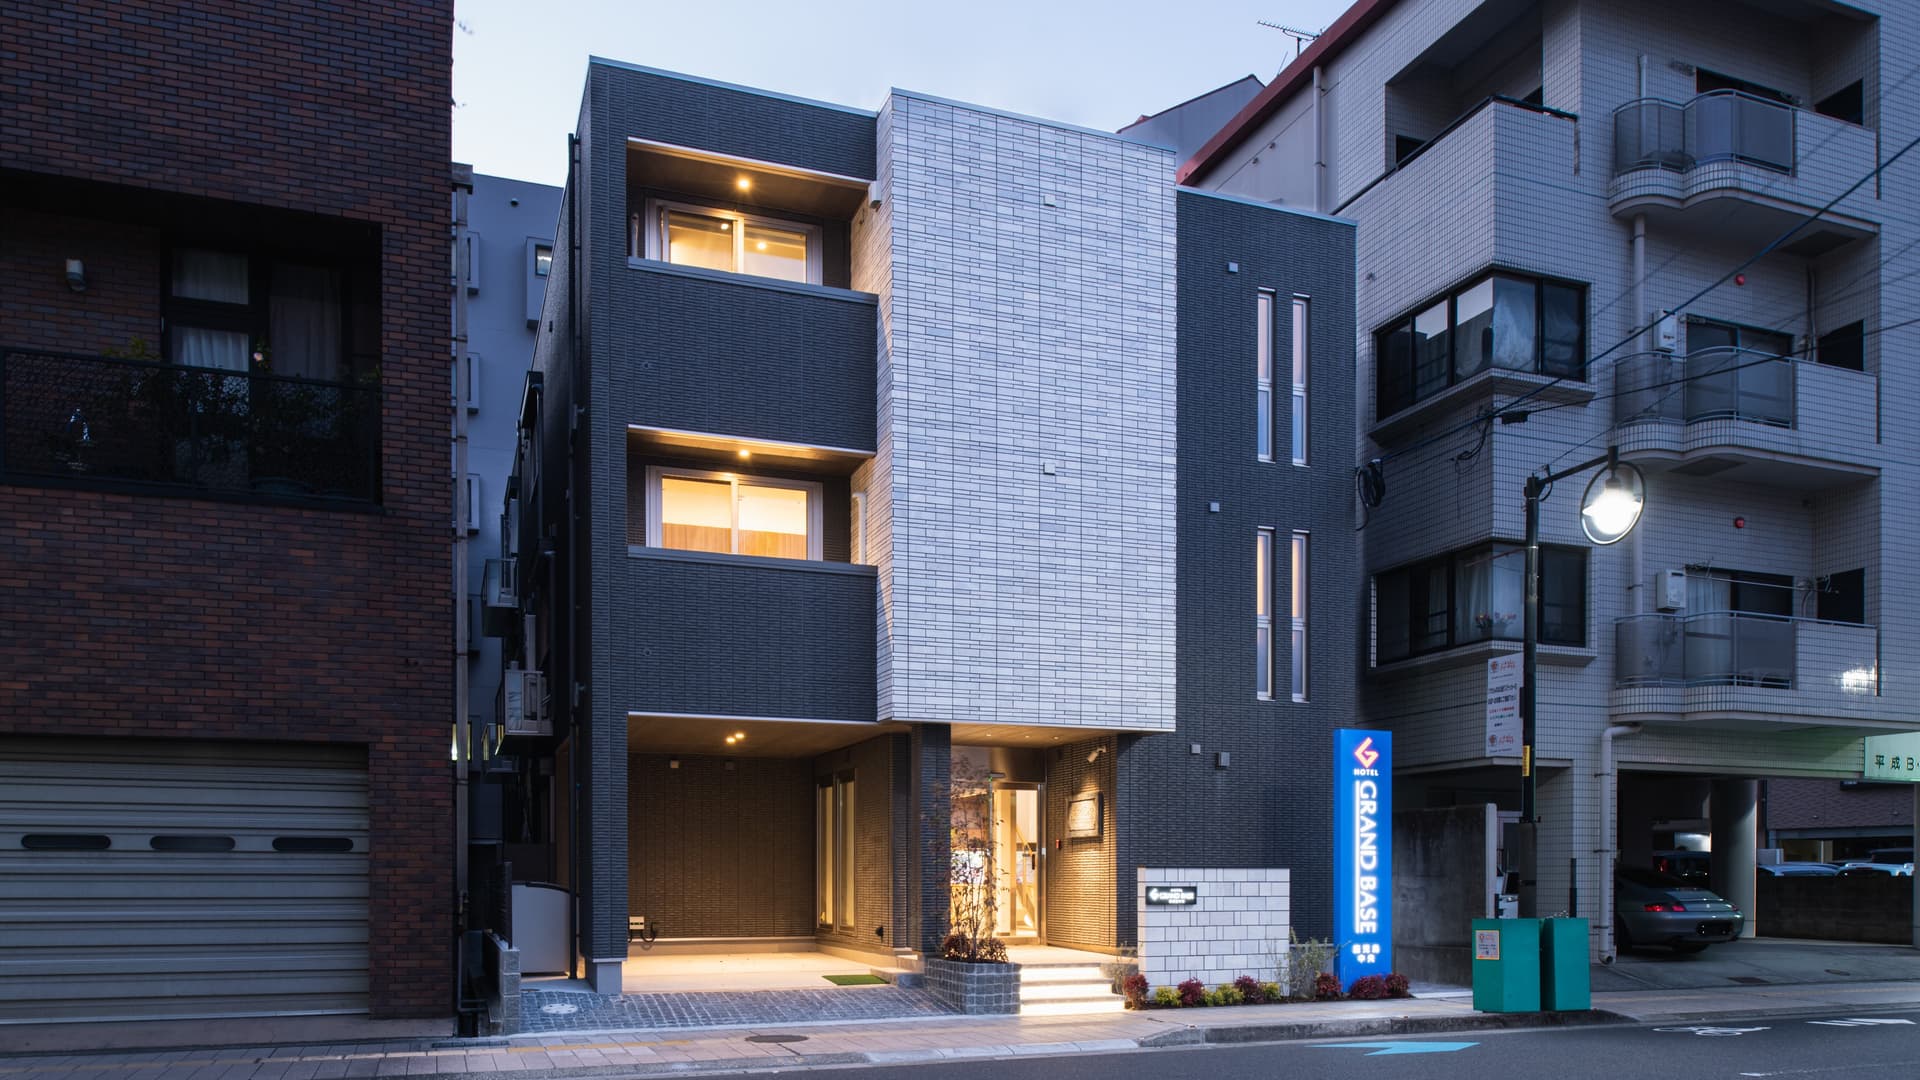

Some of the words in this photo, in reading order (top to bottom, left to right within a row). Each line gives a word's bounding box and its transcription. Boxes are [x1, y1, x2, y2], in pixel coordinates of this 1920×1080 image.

[1353, 768, 1379, 776] HOTEL
[1359, 780, 1377, 870] GRAND
[1359, 876, 1377, 934] BASE
